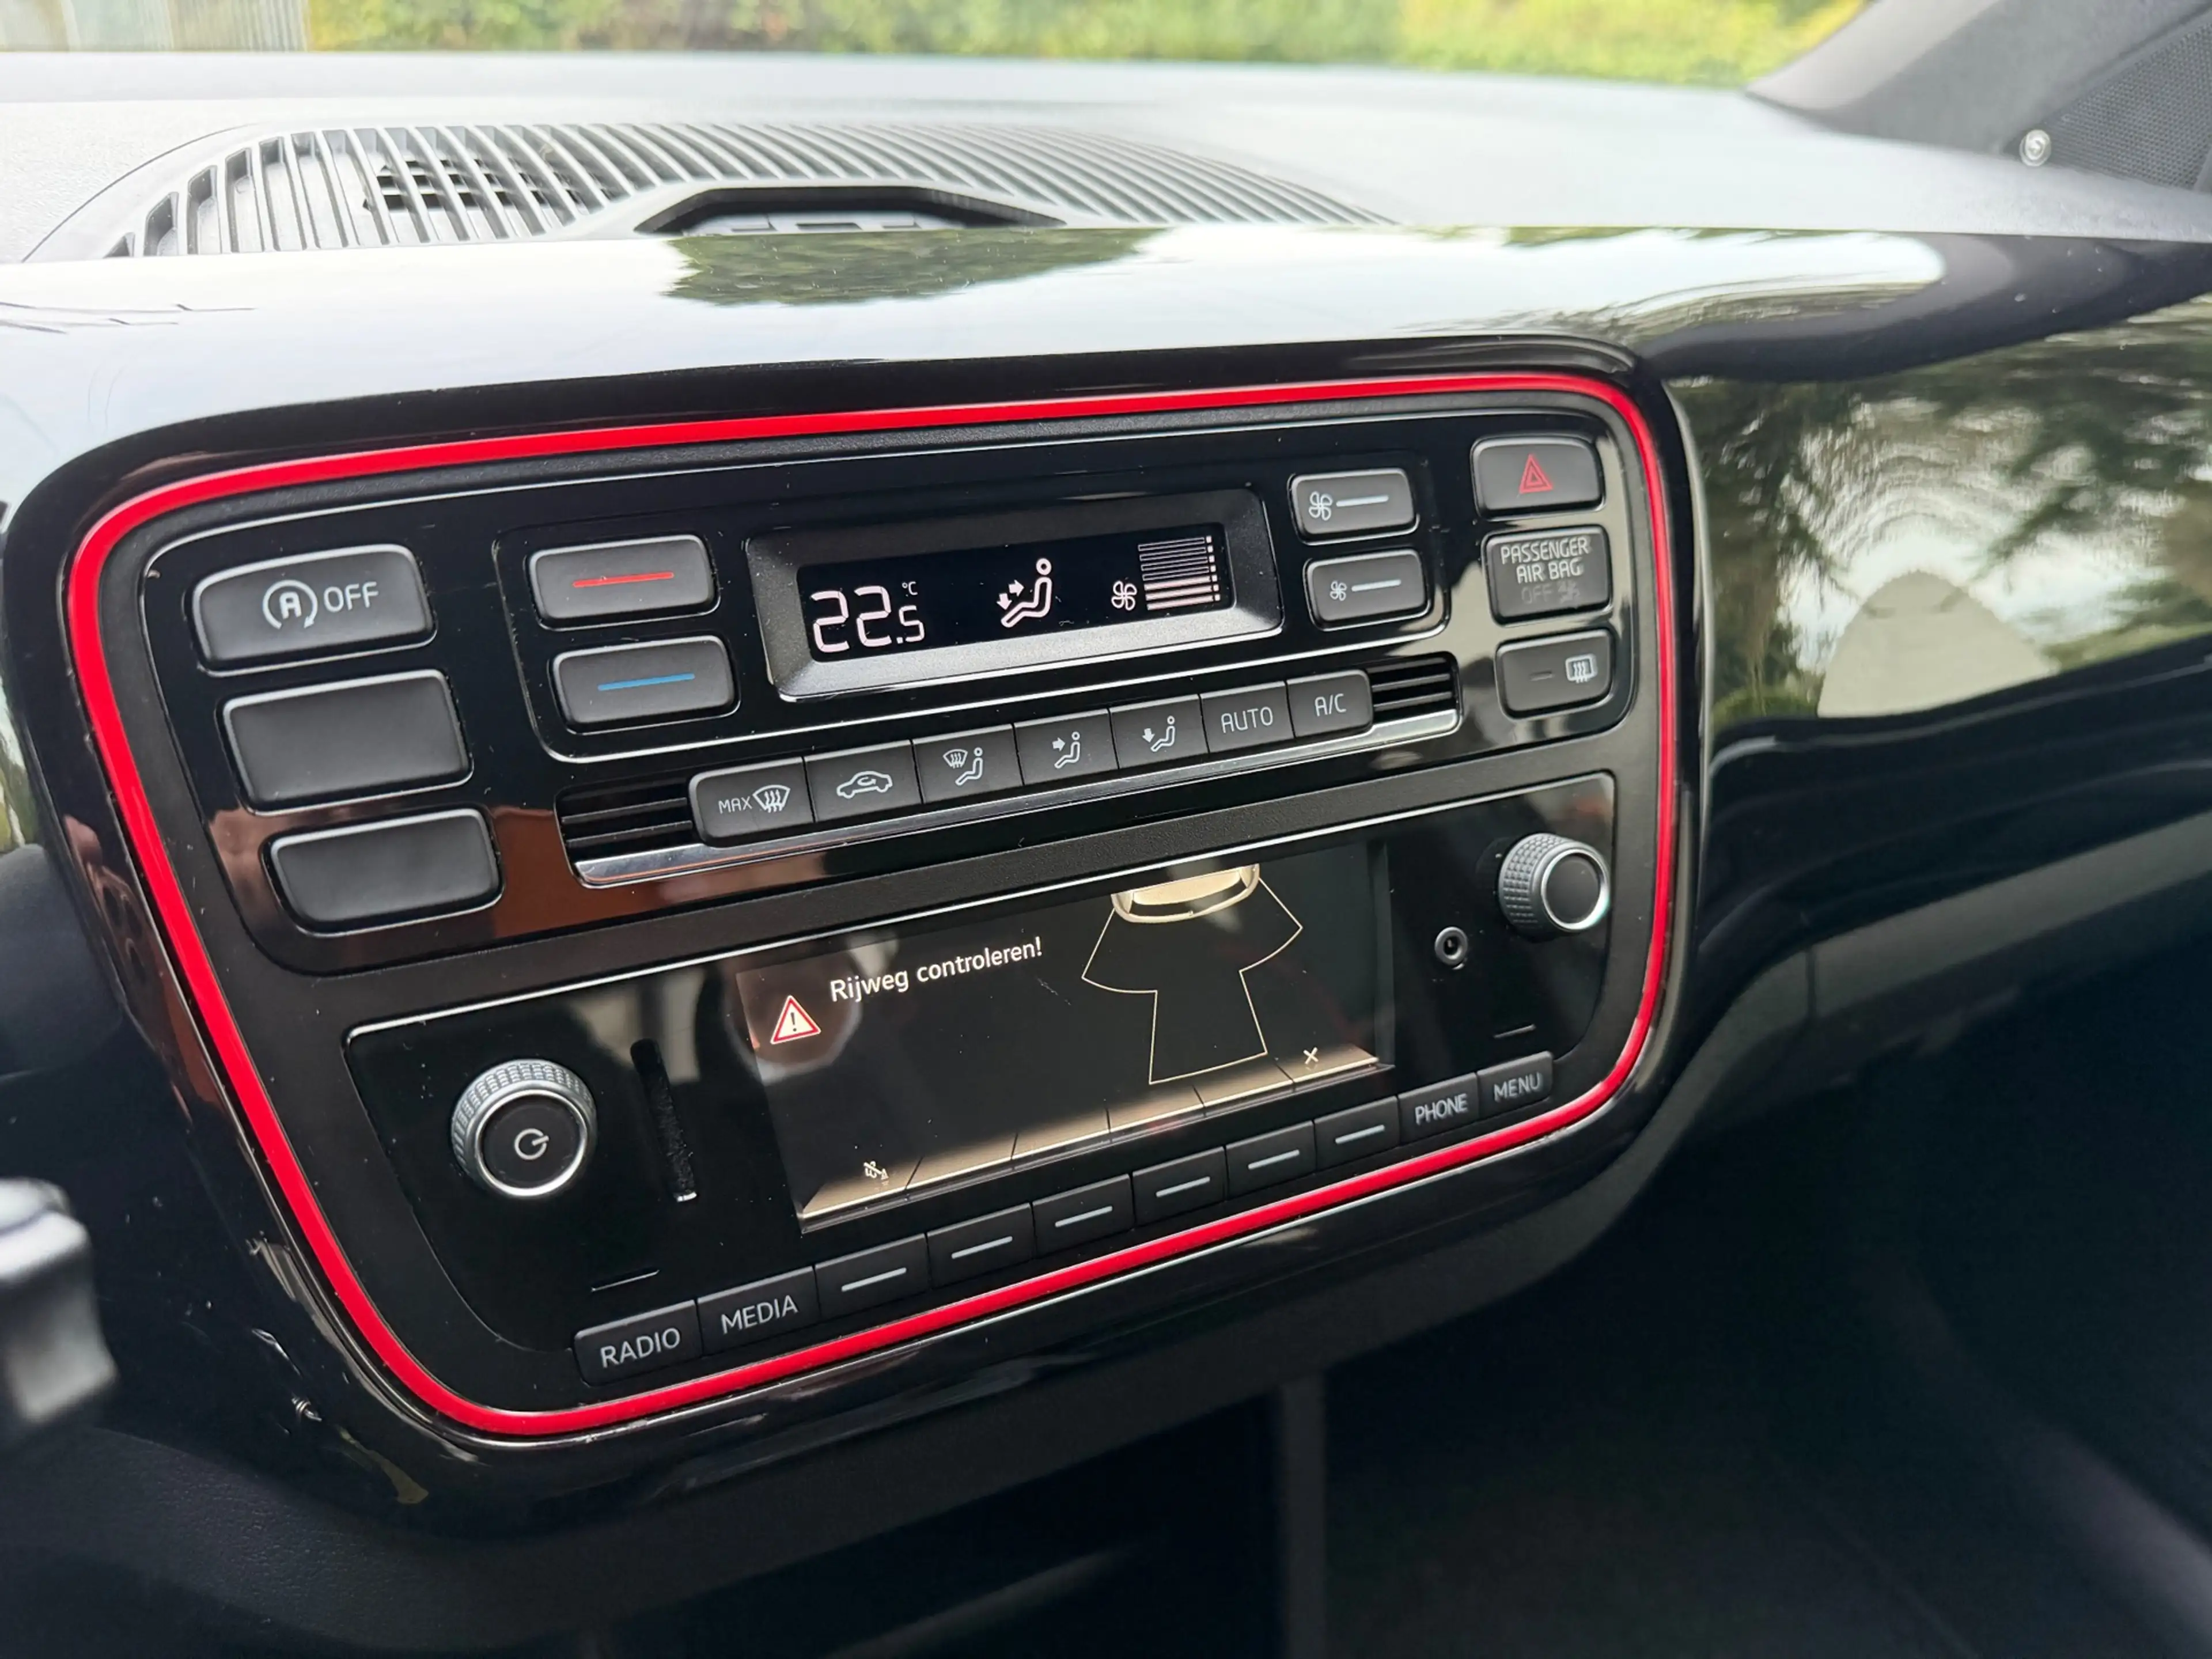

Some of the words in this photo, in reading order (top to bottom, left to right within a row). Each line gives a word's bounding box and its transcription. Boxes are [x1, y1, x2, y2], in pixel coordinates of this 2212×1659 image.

[1501, 536, 1590, 565] PASSENGER
[1516, 563, 1544, 584] AIR
[1548, 556, 1584, 580] BAG
[323, 581, 379, 613] OFF
[1521, 583, 1554, 605] OFF
[810, 585, 925, 654] 22.5
[1220, 706, 1274, 734] AUTO
[1314, 693, 1347, 717] A/C
[718, 796, 753, 815] MAX
[829, 969, 910, 1003] Rijweg
[915, 935, 1044, 983] controleren!
[1493, 1071, 1543, 1103] MENU
[1414, 1093, 1469, 1126] PHONE
[721, 1293, 800, 1335] MEDIA
[600, 1327, 682, 1369] RADIO
